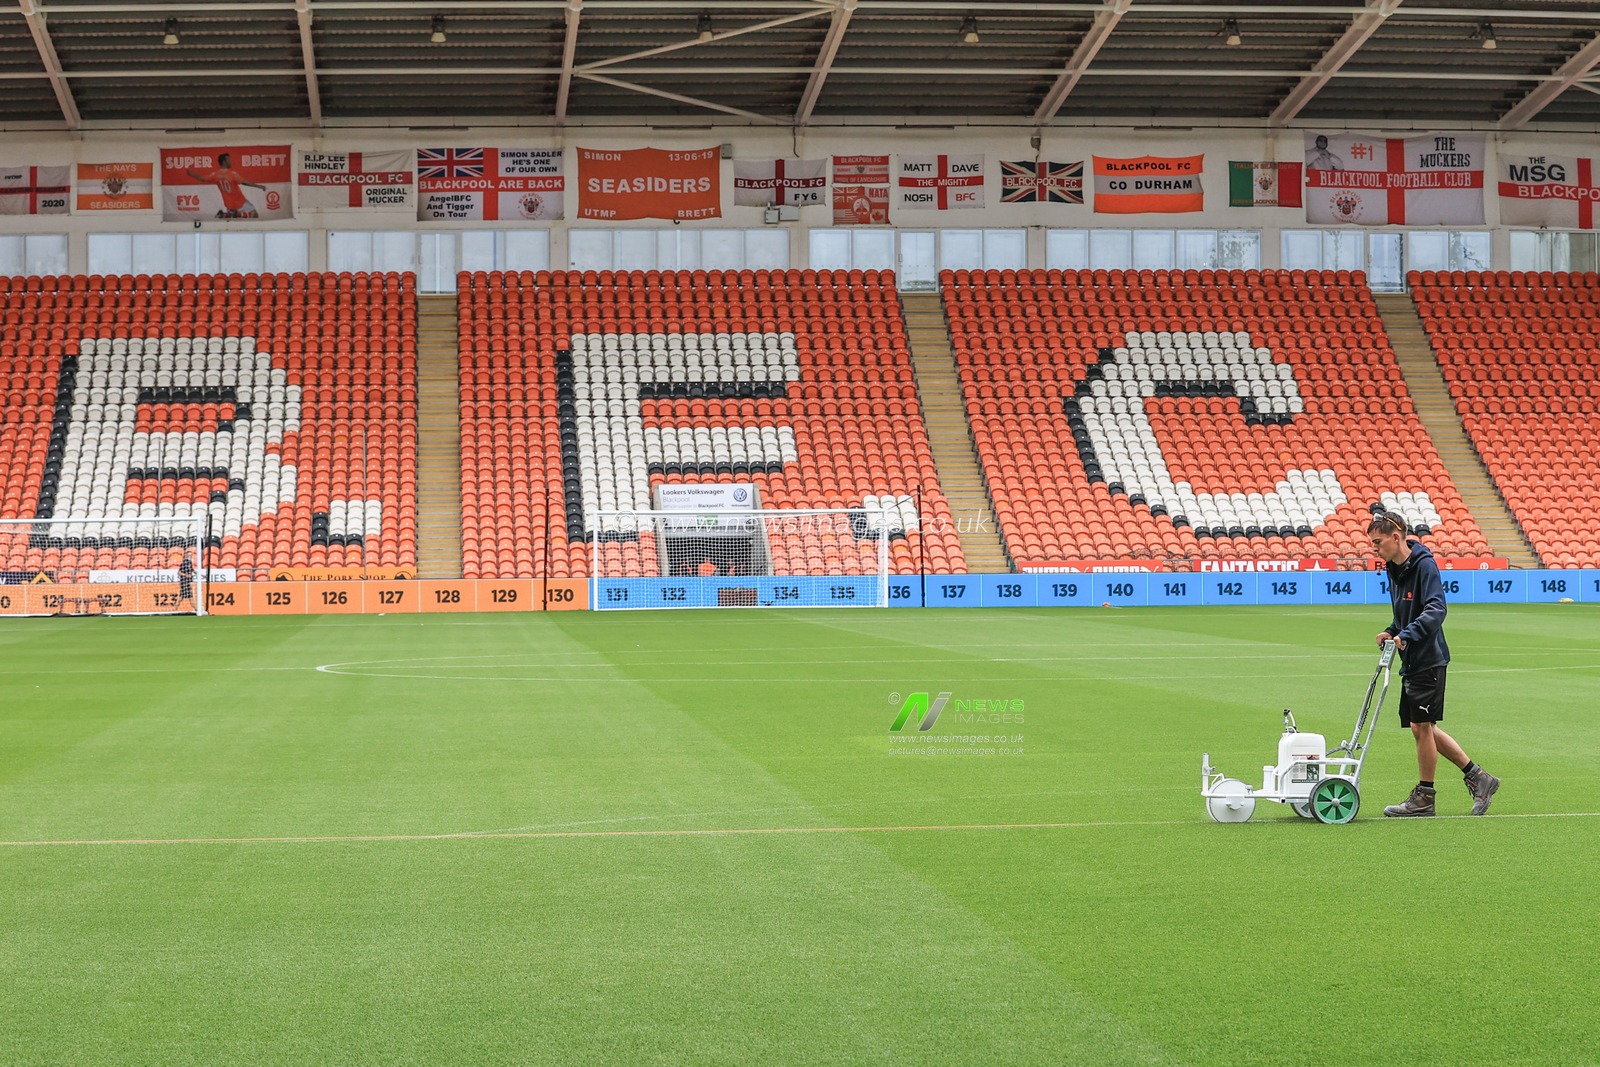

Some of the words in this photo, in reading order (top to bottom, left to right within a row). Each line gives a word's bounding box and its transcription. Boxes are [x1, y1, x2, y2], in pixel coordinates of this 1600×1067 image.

[1434, 137, 1456, 151] THE
[304, 154, 324, 162] R.I.P
[328, 154, 345, 162] LEE
[584, 151, 621, 161] SIMON
[1350, 143, 1373, 161] #1
[165, 156, 212, 169] SUPER
[241, 154, 287, 167] BRETT
[1420, 153, 1471, 168] MUCKERS
[1528, 156, 1546, 164] THE
[113, 164, 137, 172] NAYS
[904, 163, 932, 172] MATT
[952, 164, 979, 173] DAVE
[1106, 163, 1172, 171] BLACKPOOL
[1509, 164, 1566, 182] MSG
[308, 174, 382, 184] BLACKPOOL
[388, 174, 403, 183] FC
[420, 180, 495, 190] BLACKPOOL
[498, 180, 524, 189] ARE
[528, 179, 563, 189] BACK
[588, 177, 711, 194] SEASIDERS
[737, 180, 806, 188] BLACKPOOL
[809, 179, 823, 187] FC
[1007, 177, 1061, 187] BLACKPOOL
[1109, 181, 1127, 190] CO
[1135, 180, 1193, 190] DURHAM
[1320, 171, 1383, 188] BLACKPOOL
[1386, 172, 1440, 188] FOOTBALL
[1444, 172, 1472, 187] CLUB
[365, 188, 407, 196] ORIGINAL
[904, 193, 933, 202] NOSH
[956, 192, 976, 201] BFC
[42, 199, 65, 207] 2020
[90, 201, 140, 209] SEASIDERS
[177, 195, 200, 206] FY6
[368, 196, 404, 204] MUCKER
[429, 195, 471, 203] AngelBFC
[445, 203, 474, 212] Tigger
[584, 208, 617, 217] UTMP
[678, 207, 715, 217] BRETT
[688, 489, 725, 497] Volkswagen
[1200, 560, 1299, 572] FANTASTIC
[127, 574, 174, 582] KITCHEN
[941, 585, 966, 599] 137
[996, 584, 1022, 598] 138
[1052, 584, 1078, 597] 139
[1106, 583, 1133, 597] 140
[1163, 583, 1186, 596] 141
[1217, 582, 1243, 596] 142
[1271, 582, 1297, 595] 143
[1325, 581, 1352, 595] 144
[1442, 580, 1460, 594] 46
[1487, 580, 1513, 593] 147
[1541, 579, 1566, 593] 148
[208, 592, 235, 606] 124
[266, 591, 291, 605] 125
[322, 591, 348, 605] 126
[378, 590, 404, 604] 127
[435, 590, 460, 604] 128
[491, 589, 517, 603] 129
[547, 588, 574, 602] 130
[606, 587, 629, 601] 131
[661, 587, 687, 601] 132
[773, 586, 799, 600] 134
[829, 586, 855, 600] 135
